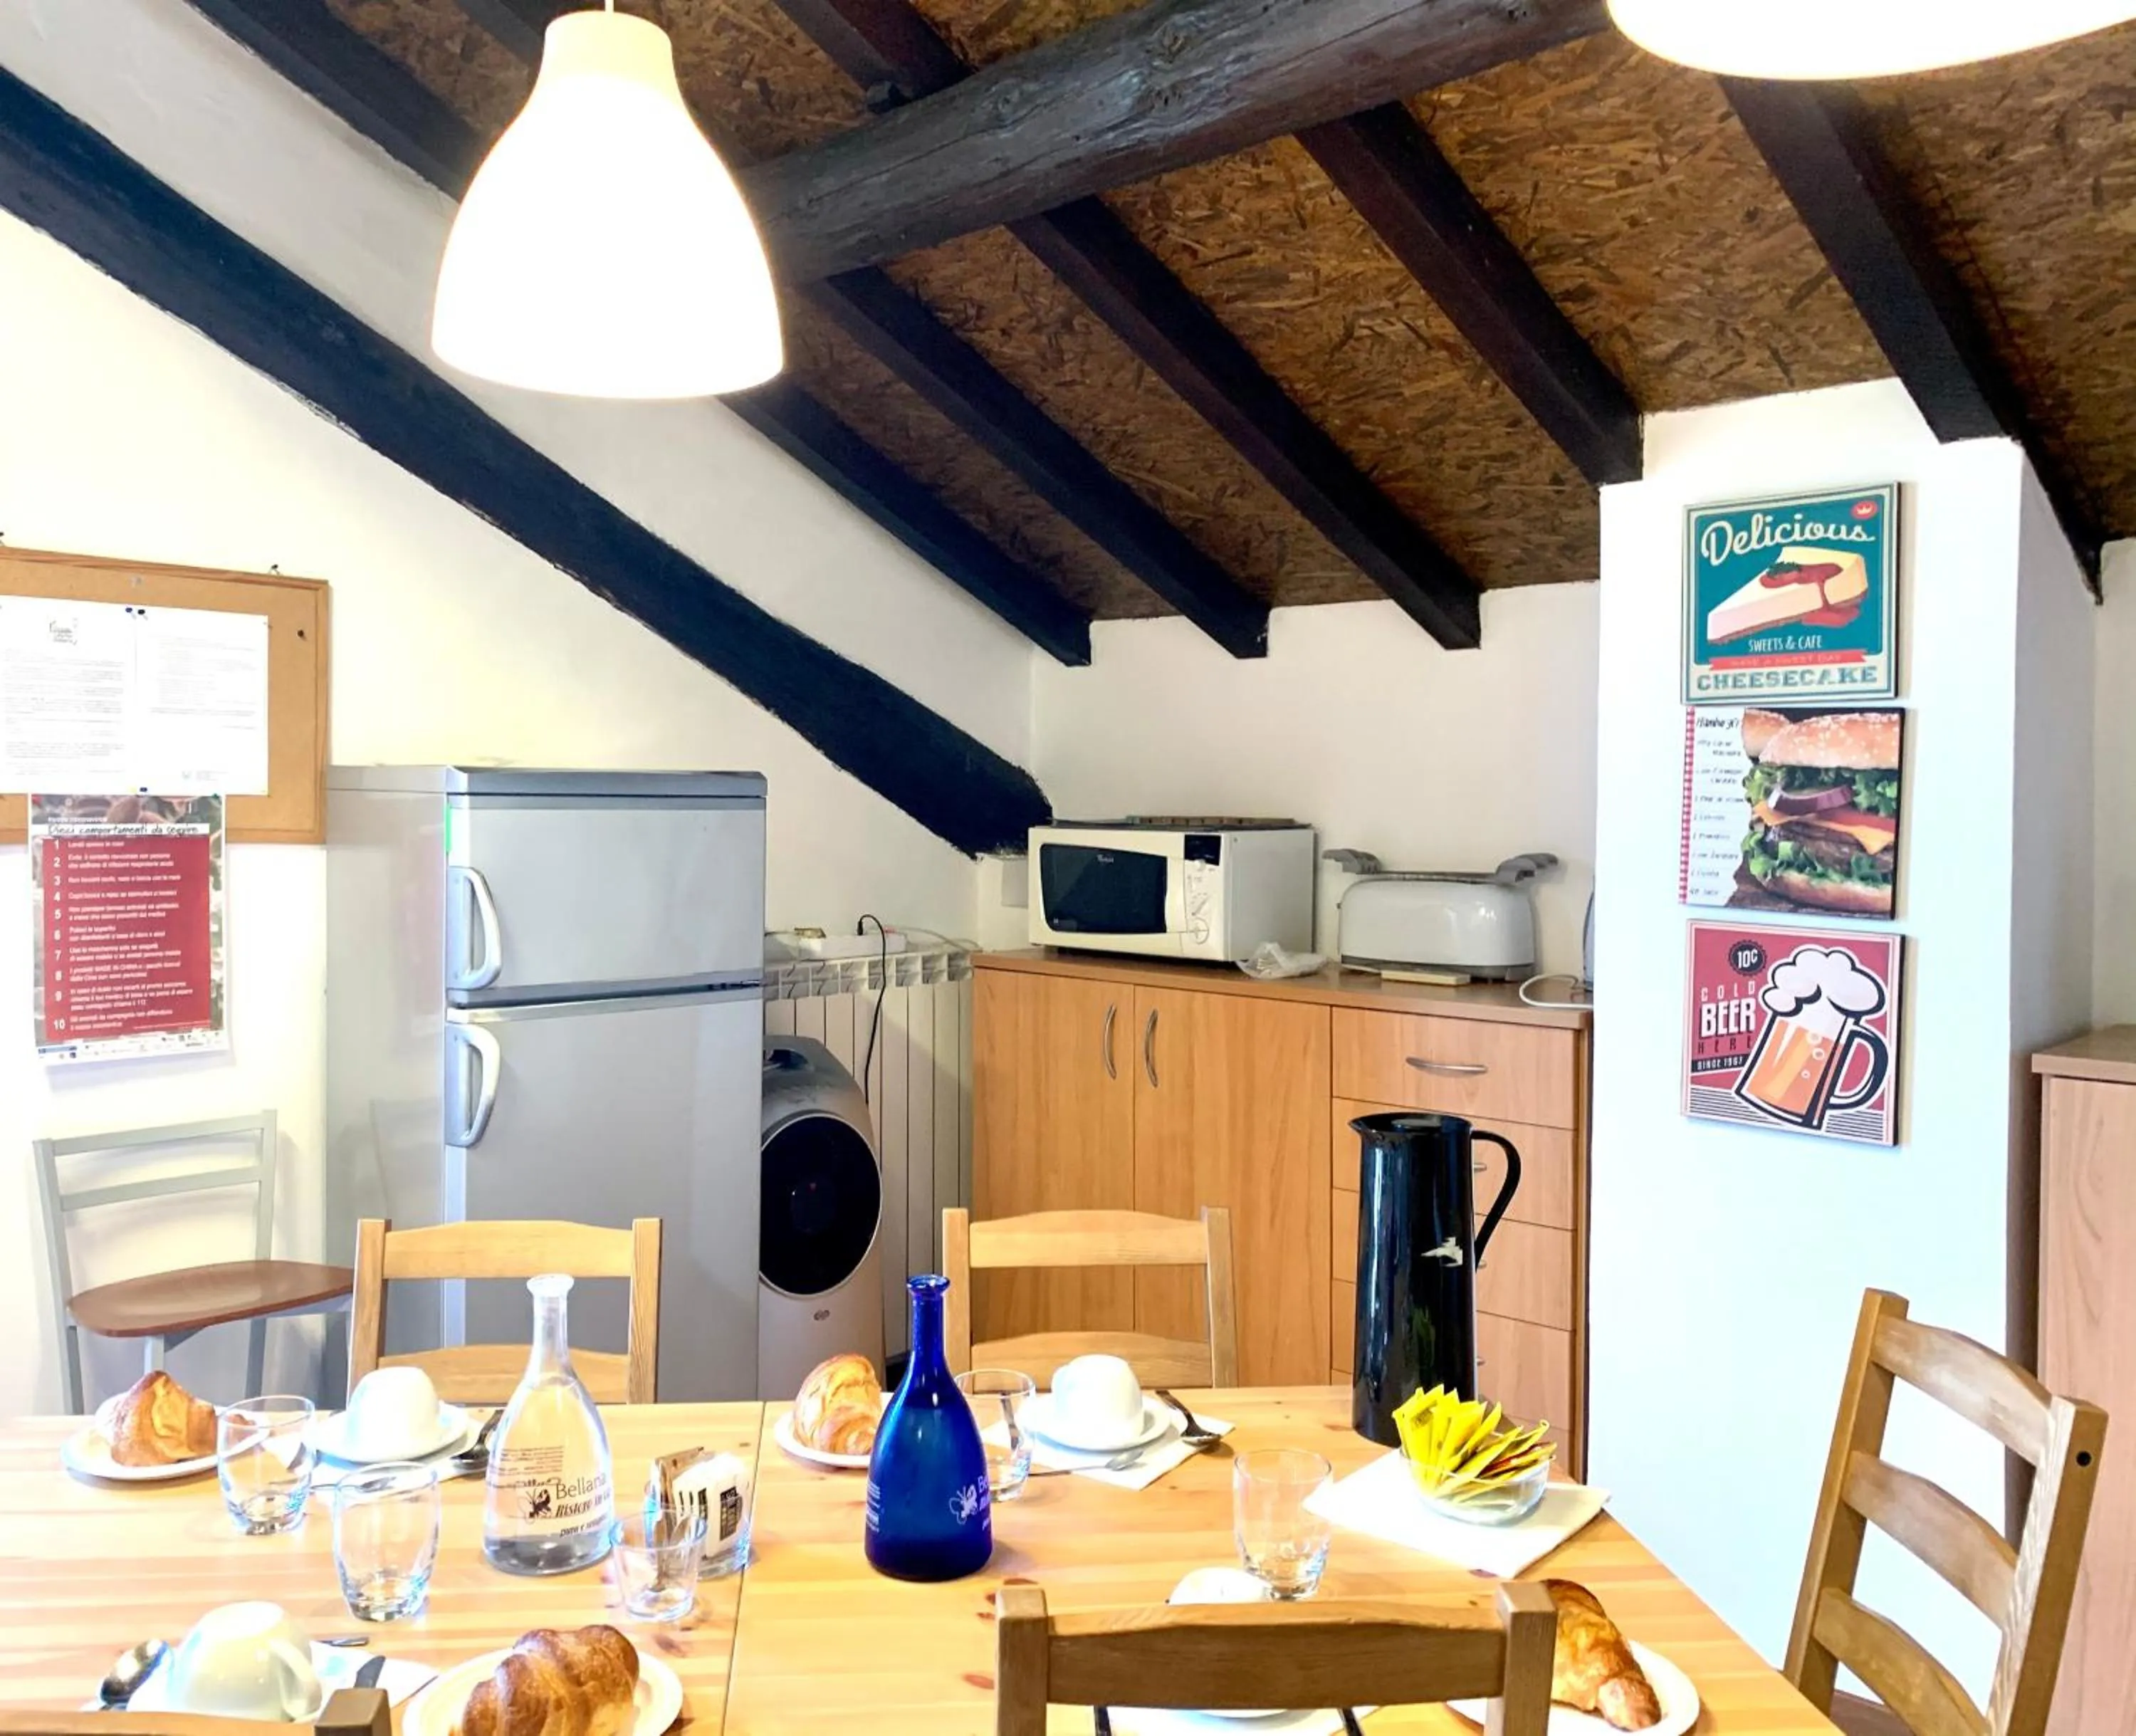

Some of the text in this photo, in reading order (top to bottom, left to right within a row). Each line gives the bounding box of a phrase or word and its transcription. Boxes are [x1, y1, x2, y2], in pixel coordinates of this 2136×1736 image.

[1700, 513, 1876, 566] Delicious
[1748, 637, 1784, 653] SWEETS
[1785, 635, 1796, 651] &
[1697, 666, 1878, 691] CHEESECAKE
[79, 822, 148, 835] comportamenti
[53, 857, 61, 867] 2
[53, 891, 61, 901] 4
[1700, 981, 1756, 1002] COLD
[53, 1019, 66, 1030] 10
[1700, 997, 1756, 1039] BEER
[1697, 1035, 1752, 1055] HERE
